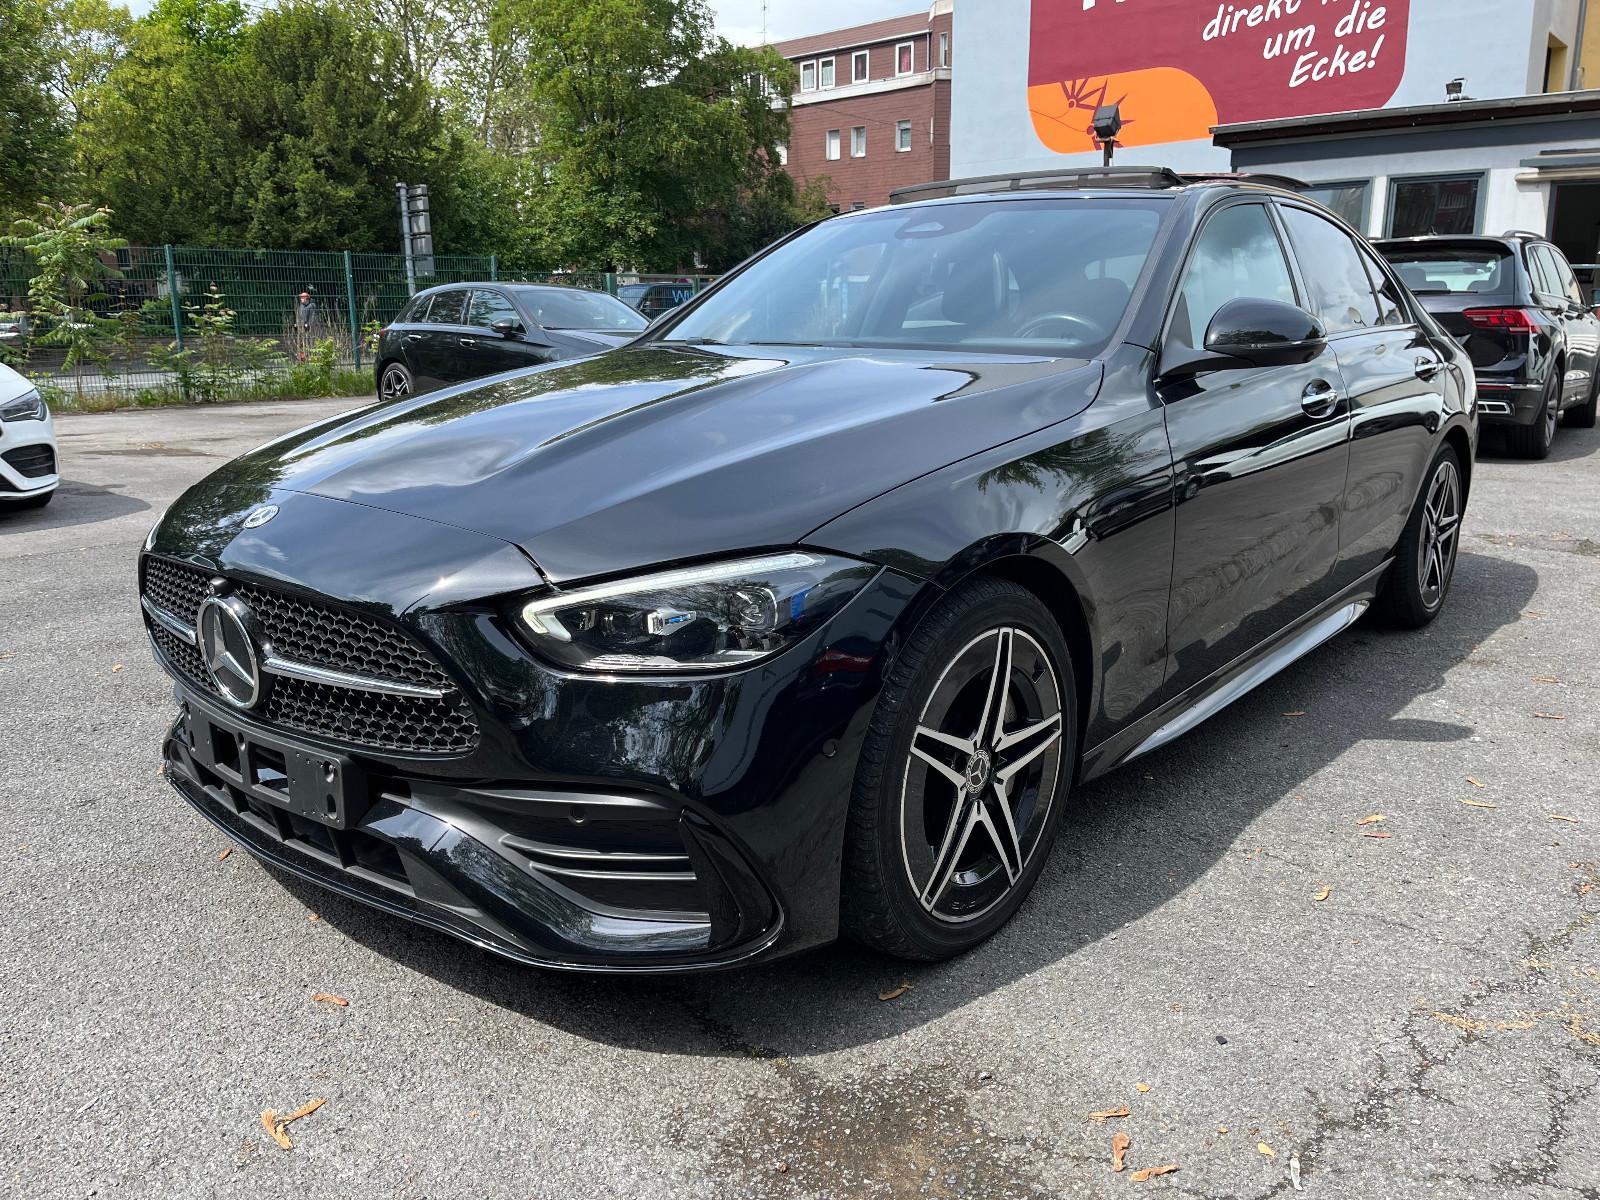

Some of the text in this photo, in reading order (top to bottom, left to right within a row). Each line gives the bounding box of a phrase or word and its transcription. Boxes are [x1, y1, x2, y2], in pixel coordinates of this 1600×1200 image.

[1263, 0, 1387, 59] um die
[1288, 34, 1385, 88] Ecke!
